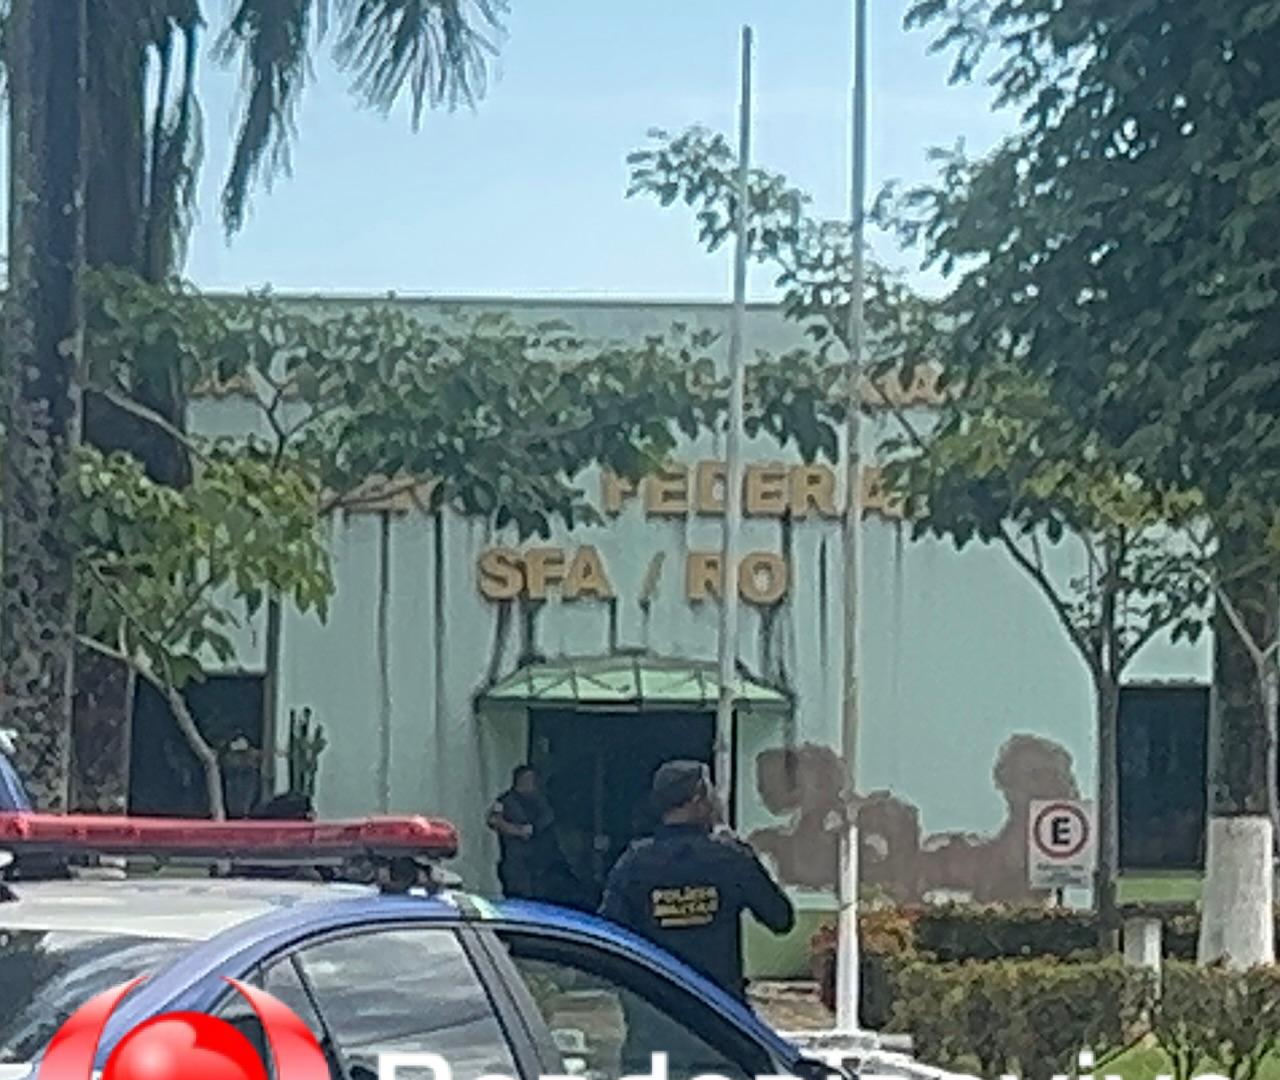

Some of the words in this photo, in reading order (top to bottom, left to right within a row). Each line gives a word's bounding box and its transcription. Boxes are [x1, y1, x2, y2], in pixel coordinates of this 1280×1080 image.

[477, 547, 616, 600] SFA
[686, 552, 788, 605] RO
[1051, 816, 1071, 846] E
